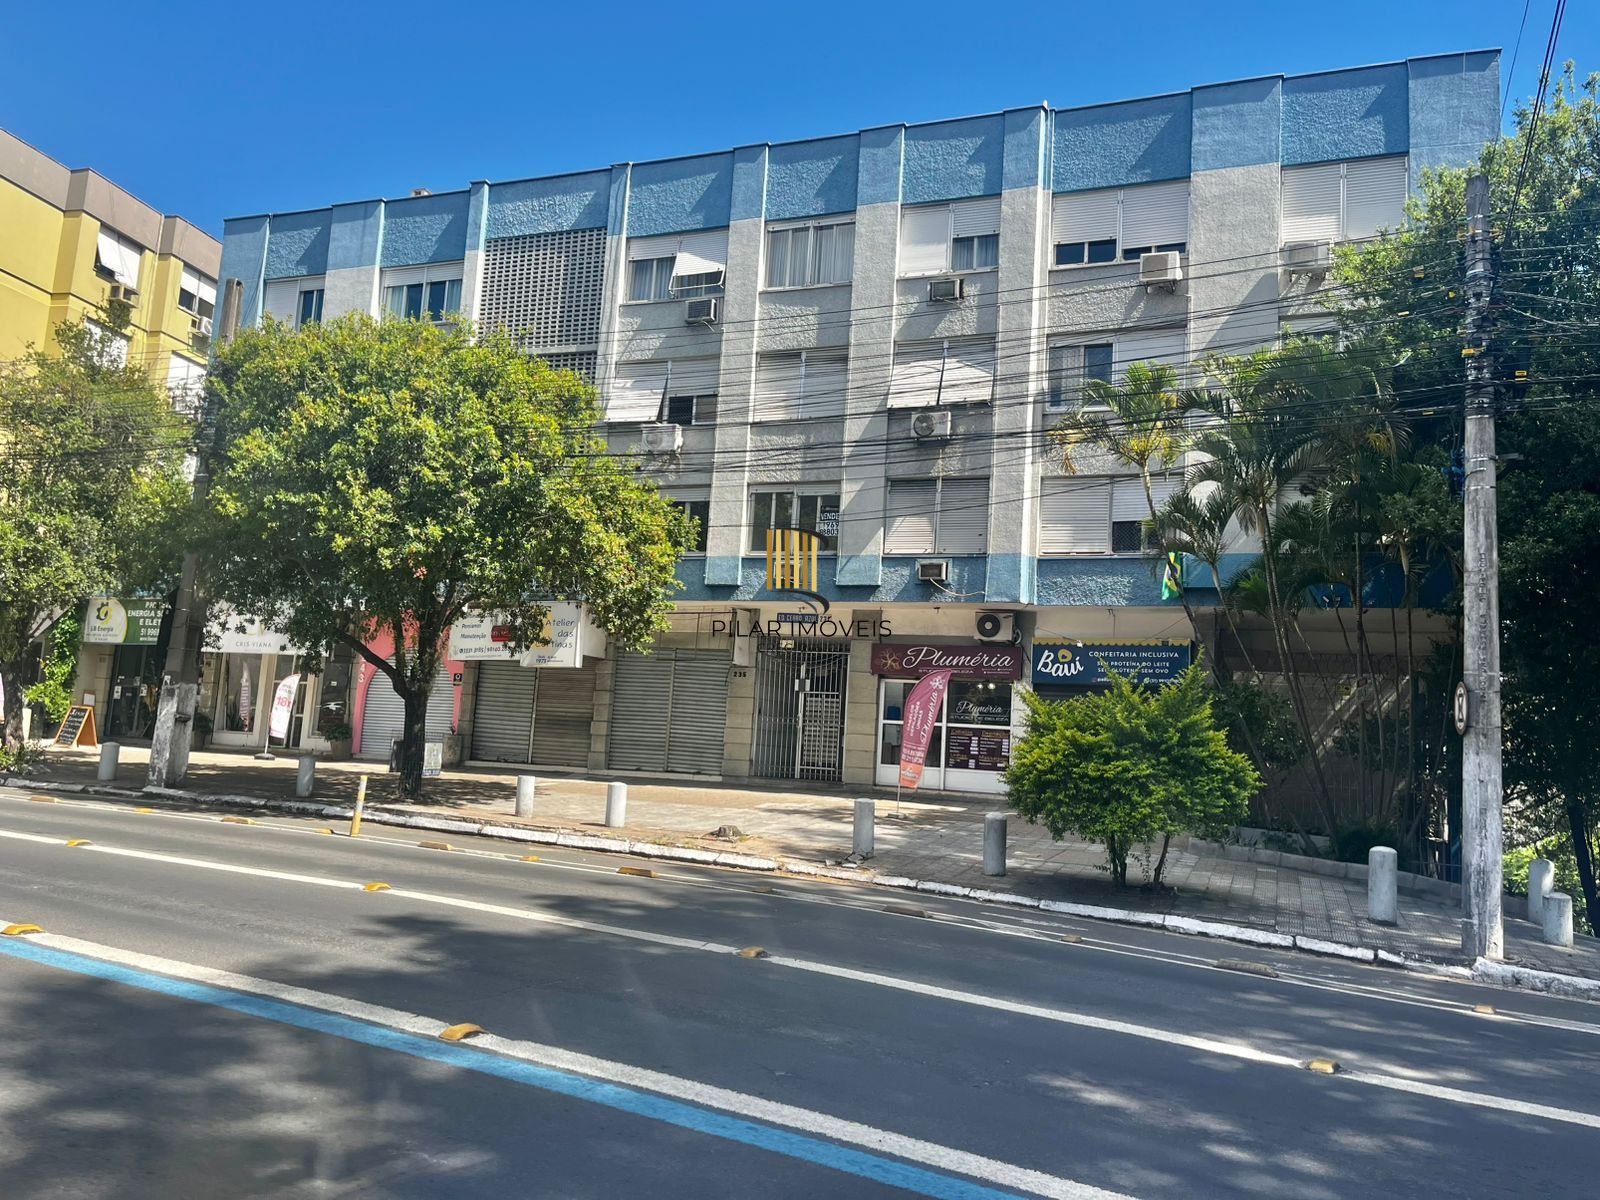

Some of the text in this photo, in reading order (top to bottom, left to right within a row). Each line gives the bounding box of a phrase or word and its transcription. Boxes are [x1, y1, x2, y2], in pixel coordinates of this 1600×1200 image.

[127, 609, 155, 617] ENERGIA
[545, 619, 575, 627] Atelier
[97, 625, 114, 634] Energia
[557, 629, 574, 638] das
[902, 646, 1014, 669] Pluméria
[955, 700, 1003, 714] Pluméria
[920, 690, 939, 745] Pluméria
